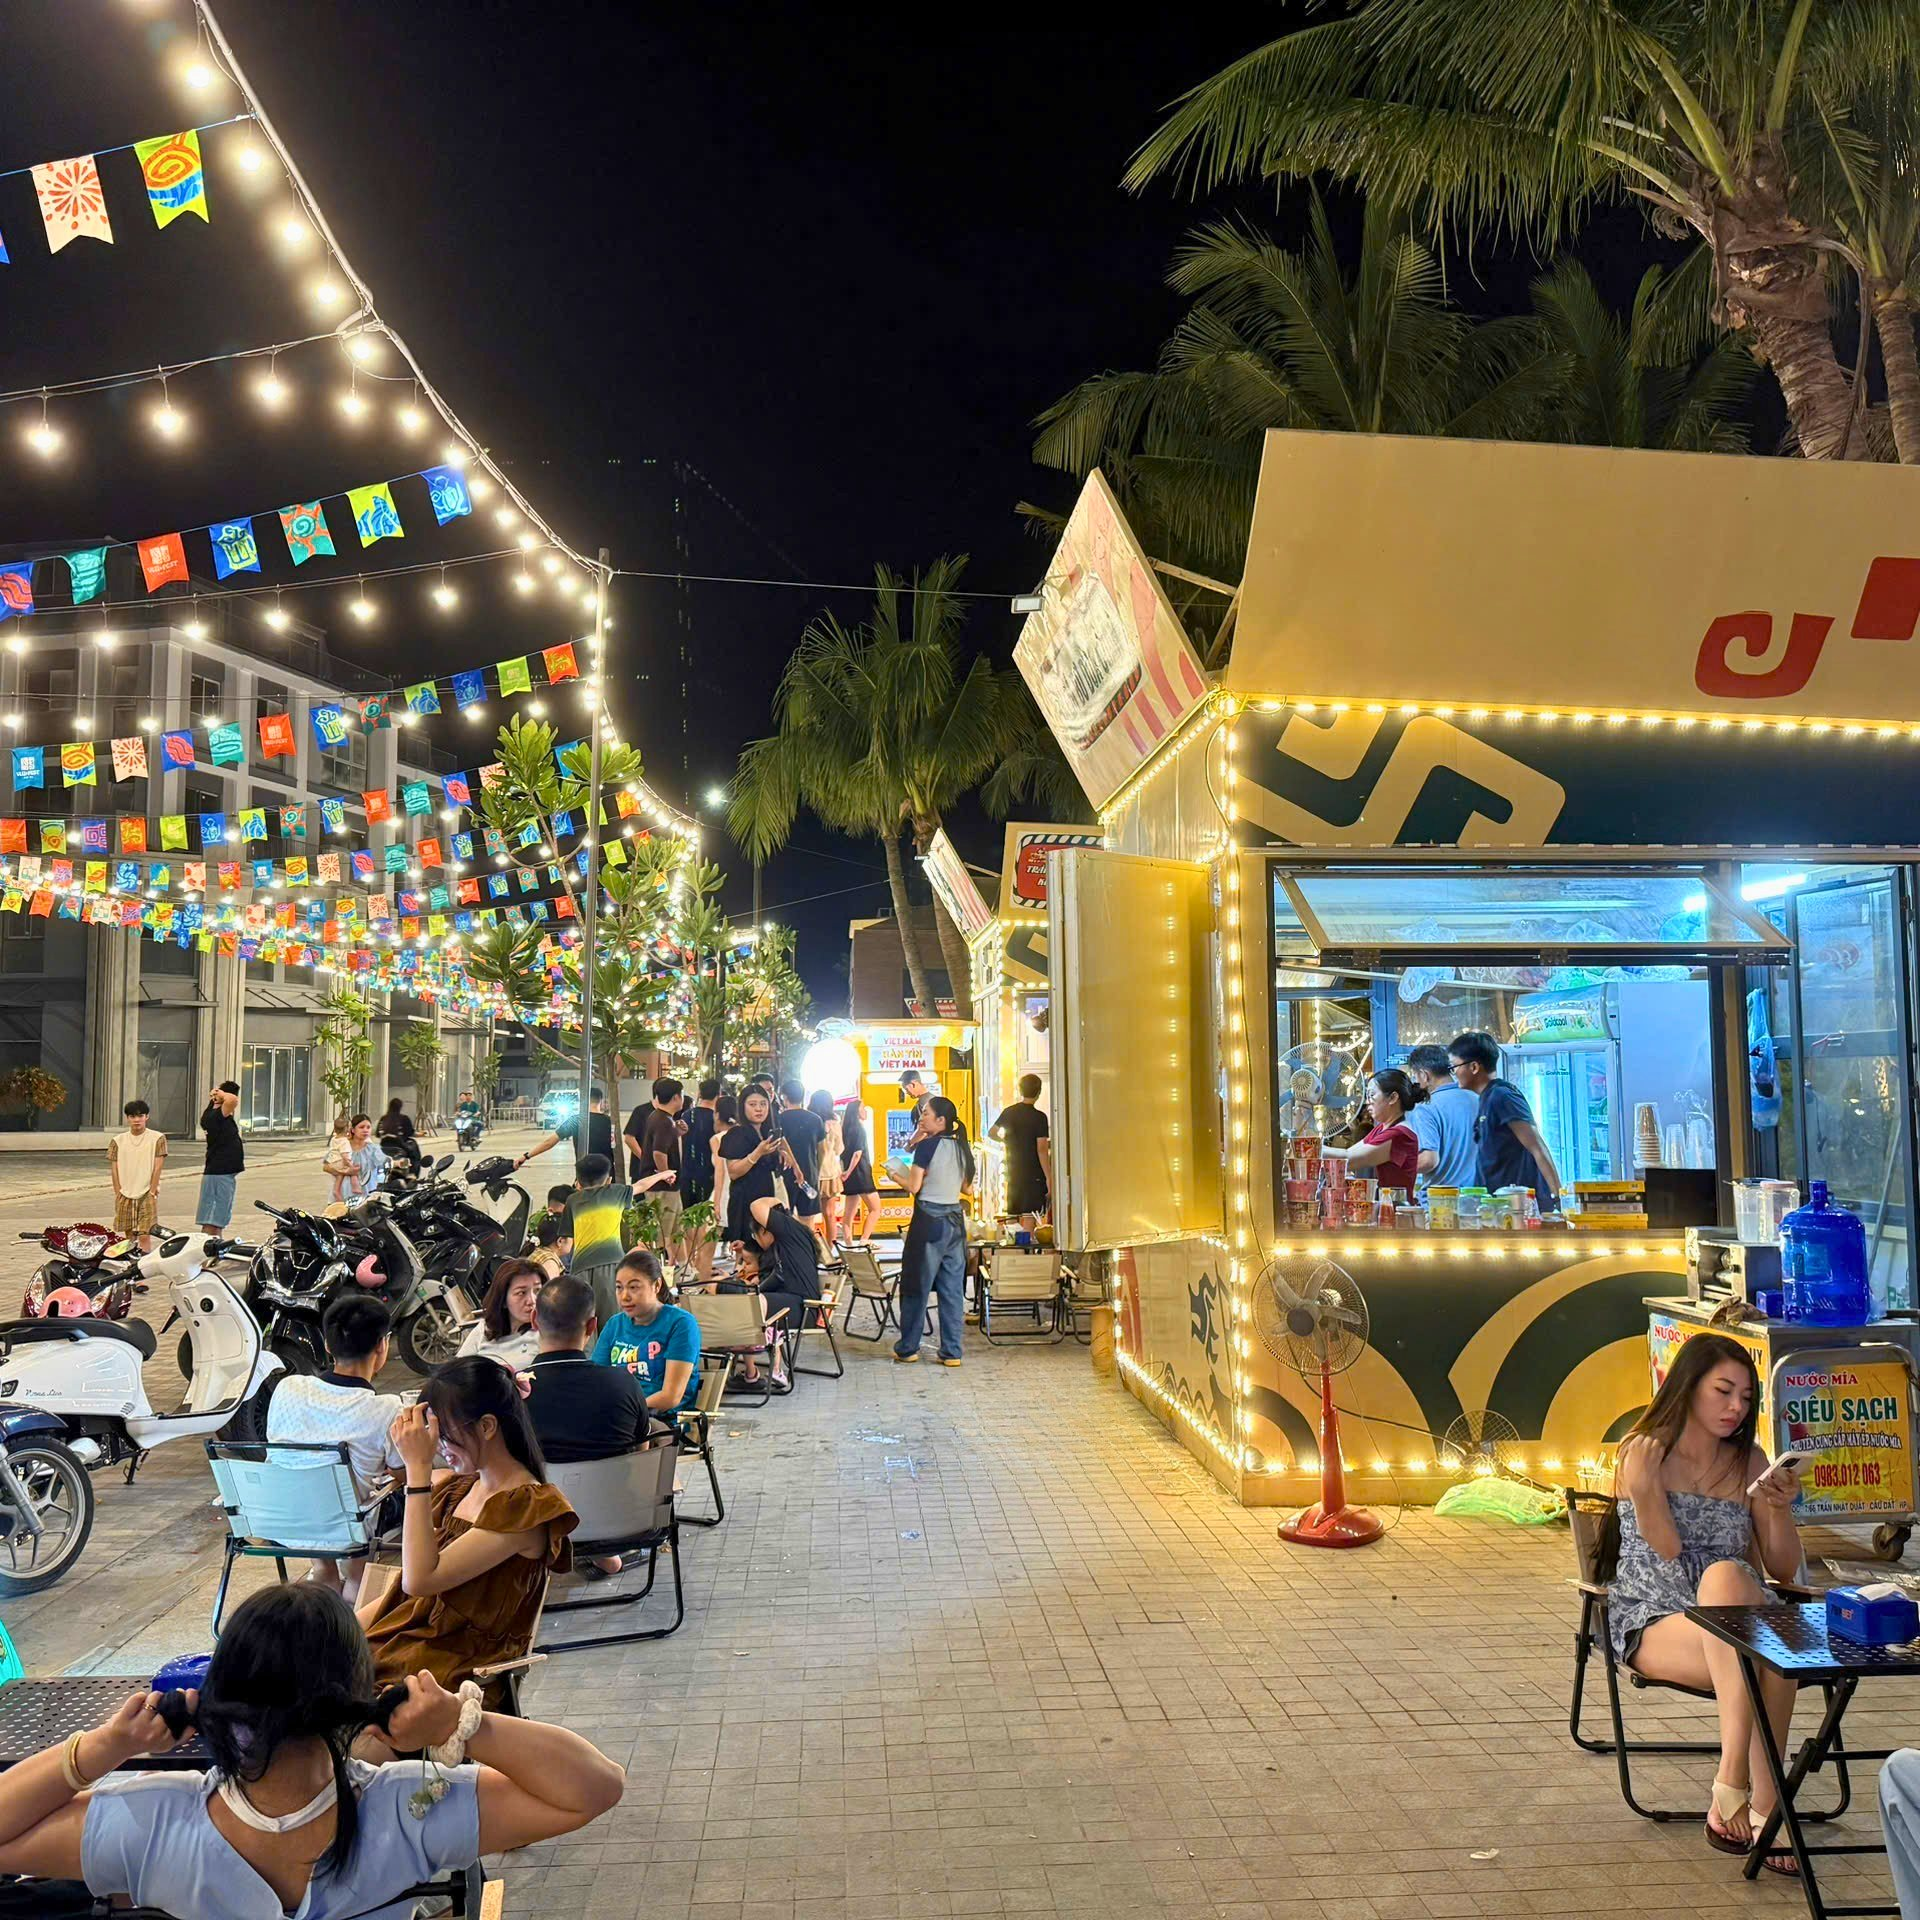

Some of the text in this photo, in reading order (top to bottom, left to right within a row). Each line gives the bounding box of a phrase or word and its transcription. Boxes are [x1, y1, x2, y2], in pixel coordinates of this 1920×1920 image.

[902, 1059, 927, 1068] NAM
[1786, 1370, 1859, 1387] NƯỚC MÍA
[1786, 1395, 1835, 1423] SIÊU
[1841, 1397, 1898, 1426] SẠCH
[1814, 1462, 1880, 1487] 0983.012 063
